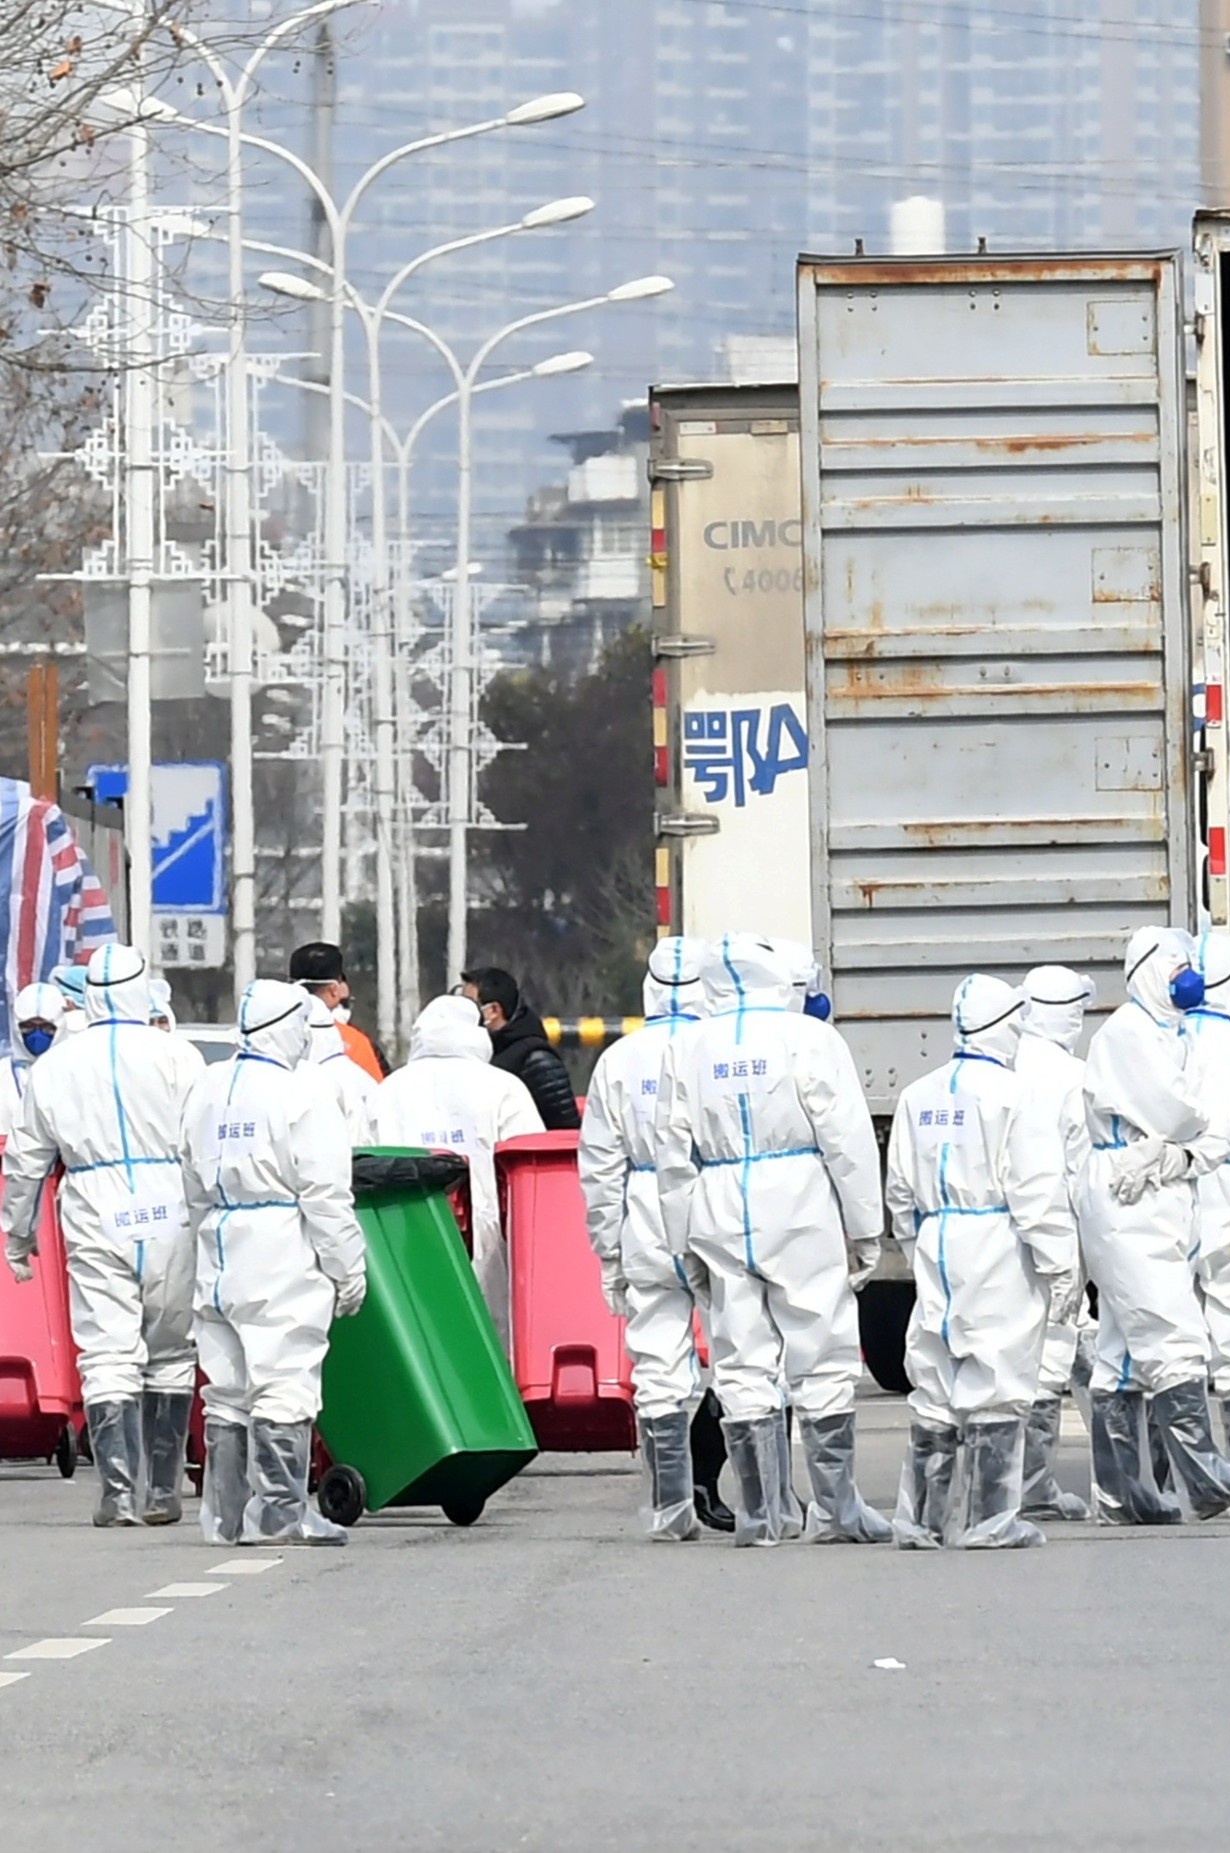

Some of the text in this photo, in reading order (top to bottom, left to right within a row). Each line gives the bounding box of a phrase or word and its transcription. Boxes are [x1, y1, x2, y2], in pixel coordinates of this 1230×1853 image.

[703, 519, 802, 550] CIMC
[713, 1059, 767, 1080] 搬运班
[918, 1109, 965, 1126] 搬运班
